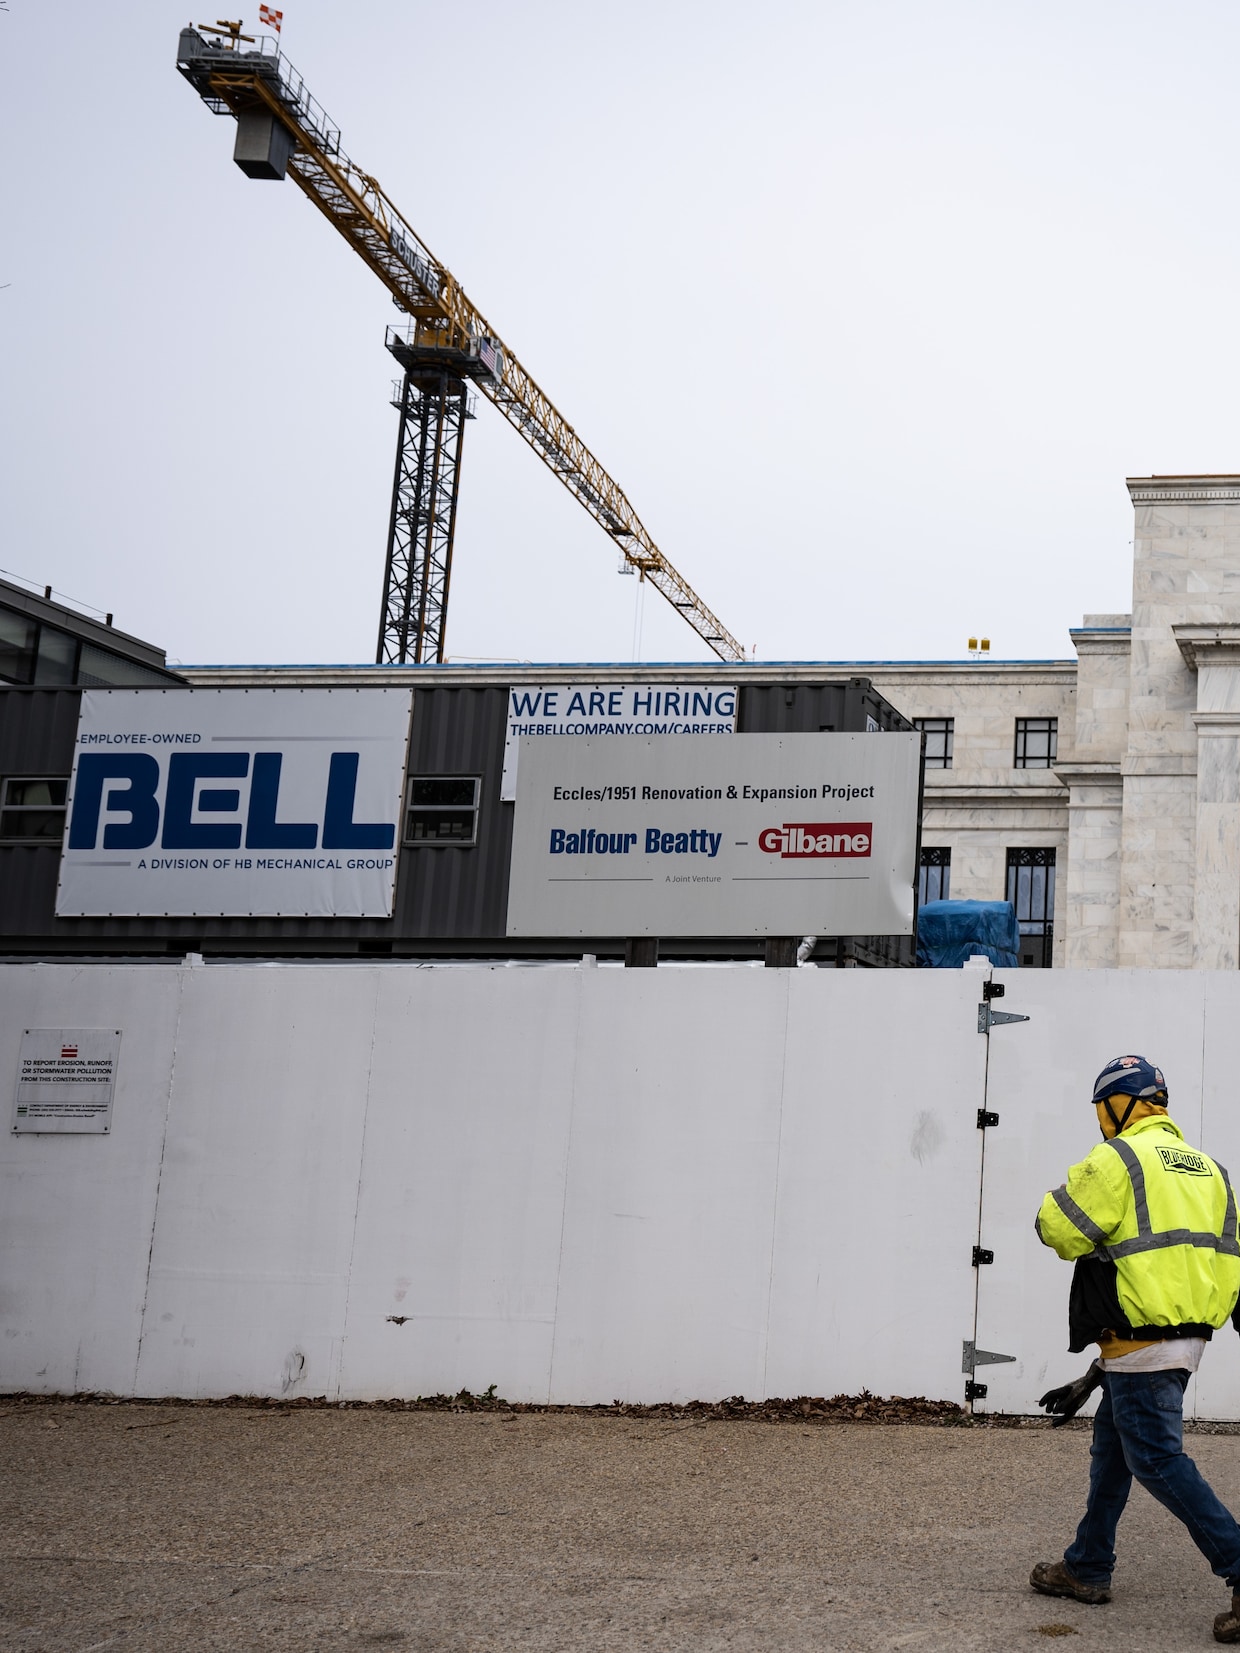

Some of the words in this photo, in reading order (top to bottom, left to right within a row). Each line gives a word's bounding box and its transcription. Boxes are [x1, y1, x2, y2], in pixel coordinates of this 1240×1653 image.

[392, 231, 439, 298] SCHUSTER
[512, 692, 558, 717] WE
[566, 692, 623, 717] ARE
[633, 692, 735, 717] HIRING
[510, 723, 732, 736] THEBELLCOMPANY.COM/CAREERS
[81, 734, 201, 744] EMPLOYEE-OWNED
[68, 752, 395, 849] BELL
[553, 786, 636, 801] Eccles/1951
[642, 786, 724, 799] Renovation
[726, 786, 737, 799] &
[742, 785, 817, 802] Expansion
[822, 785, 874, 801] Project
[550, 828, 637, 854] Balfour
[645, 828, 721, 857] Beatty
[759, 826, 870, 854] Gilbane
[138, 859, 146, 869] A
[151, 859, 208, 869] DIVISION
[213, 859, 230, 869] OF
[235, 859, 252, 869] HB
[257, 859, 342, 869] MECHANICAL
[347, 859, 393, 869] GROUP
[674, 875, 691, 883] Joint
[692, 875, 721, 883] Venture
[1161, 1150, 1206, 1170] BLUERIDGE
